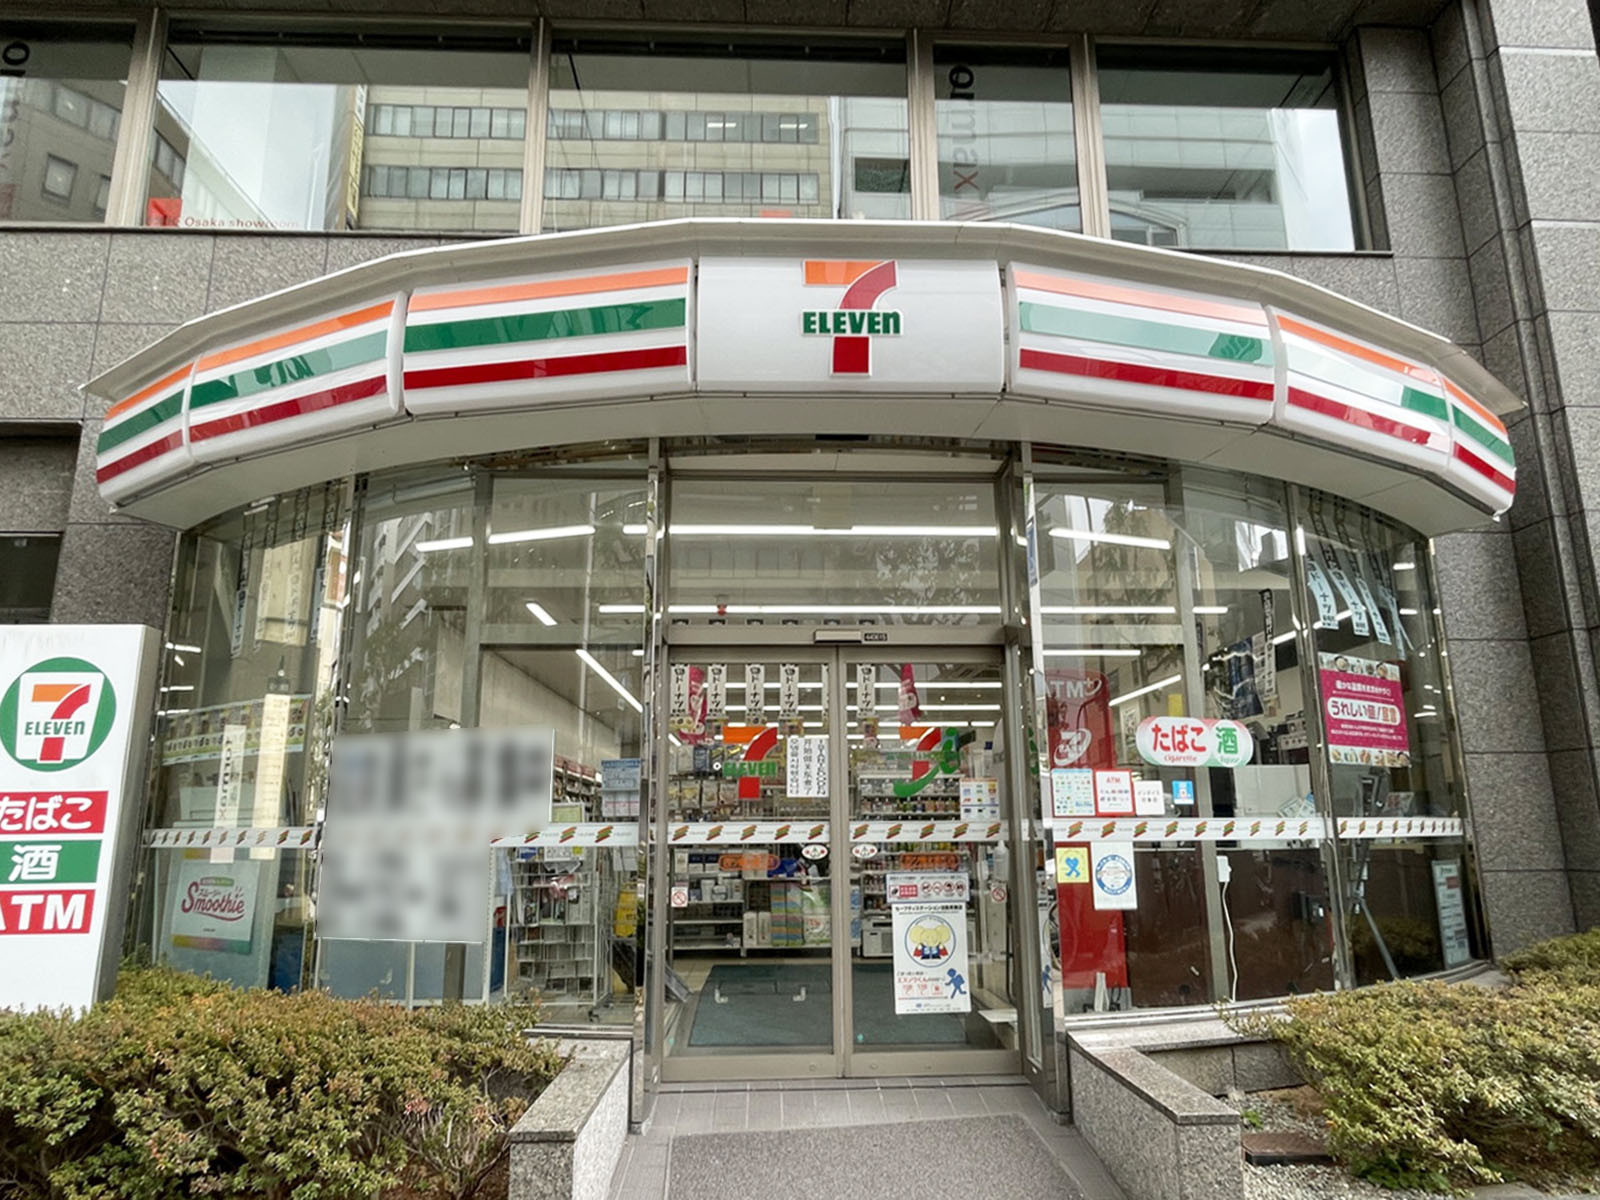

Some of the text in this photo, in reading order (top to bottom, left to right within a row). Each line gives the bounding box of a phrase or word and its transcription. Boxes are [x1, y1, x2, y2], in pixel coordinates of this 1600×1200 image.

[184, 216, 225, 227] Osaka
[805, 260, 897, 373] 7
[32, 684, 91, 761] 7
[1152, 724, 1239, 755] たばこ 酒
[0, 795, 93, 832] たばこ
[8, 844, 63, 882] 酒
[181, 881, 246, 914] Smoothie
